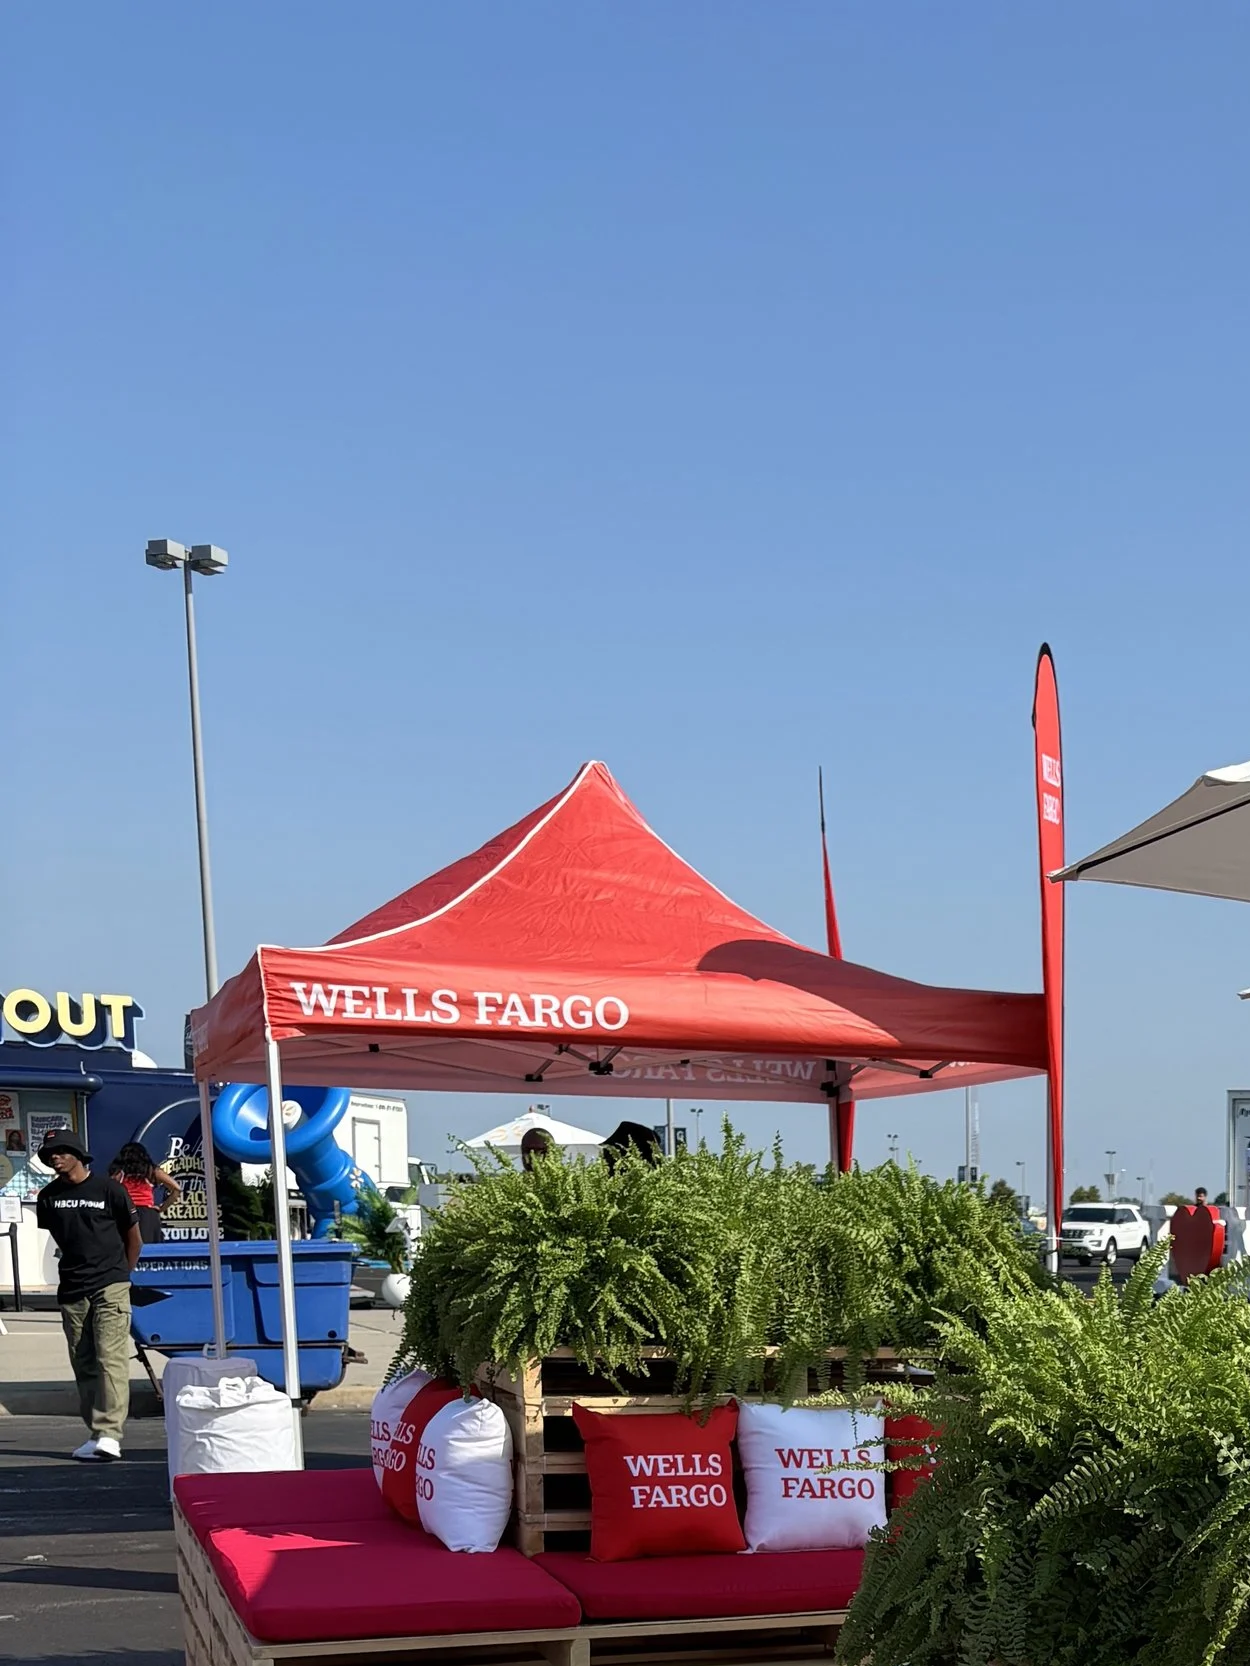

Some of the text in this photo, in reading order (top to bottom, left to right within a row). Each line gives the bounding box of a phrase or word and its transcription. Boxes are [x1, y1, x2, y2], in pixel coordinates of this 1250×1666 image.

[289, 982, 630, 1031] WELLS FARGO
[168, 1137, 190, 1158] Be
[161, 1227, 224, 1240] YOU LOE
[135, 1261, 209, 1271] OPERATIONS
[623, 1453, 722, 1477] WELLS
[631, 1484, 727, 1509] FARGO
[781, 1477, 875, 1499] FARGO
